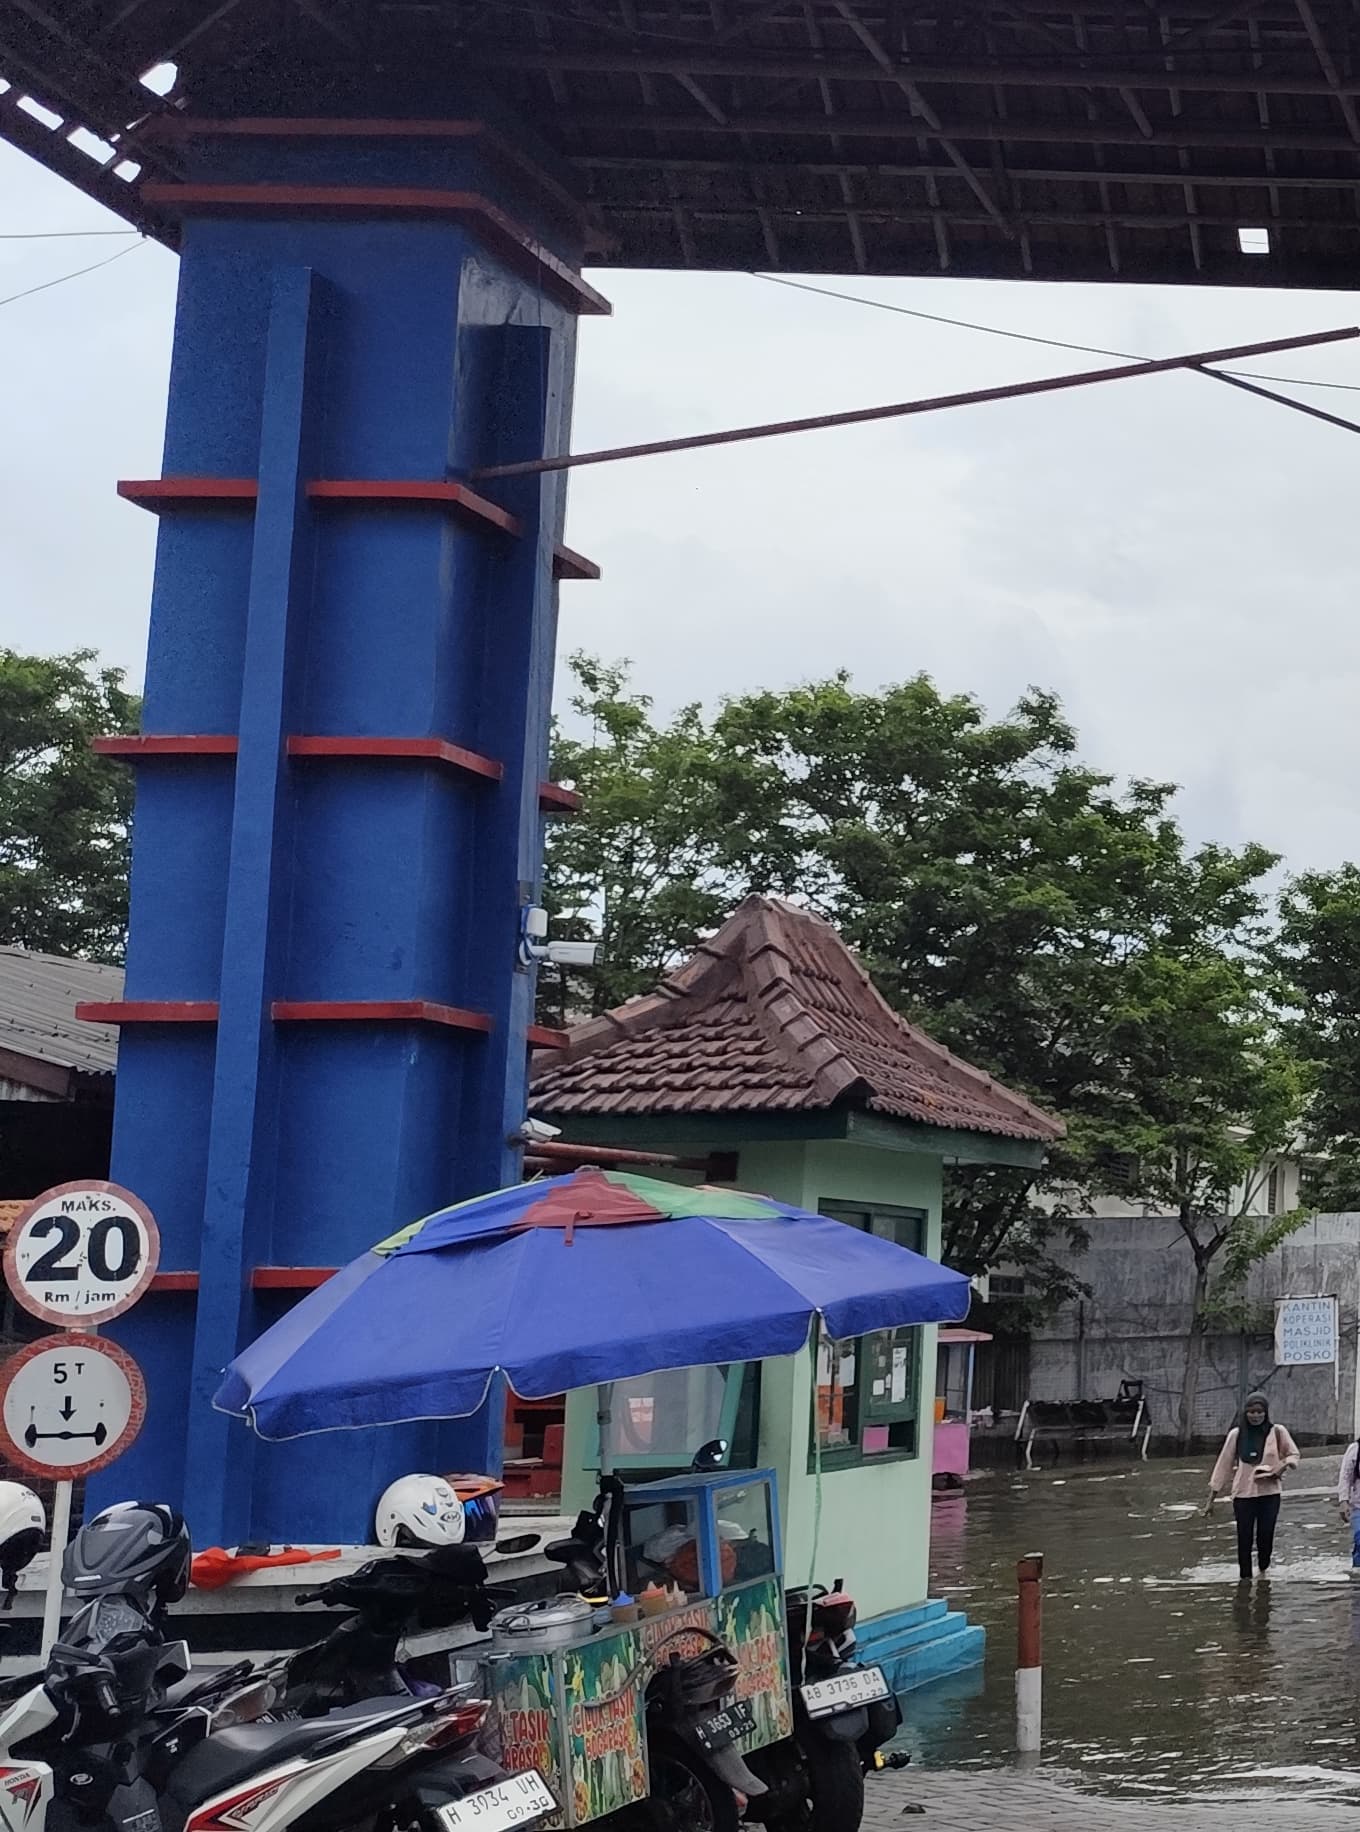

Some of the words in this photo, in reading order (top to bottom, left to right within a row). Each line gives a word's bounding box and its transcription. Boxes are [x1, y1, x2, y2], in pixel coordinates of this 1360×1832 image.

[25, 1215, 141, 1282] 20
[84, 1289, 116, 1305] jam
[1282, 1301, 1331, 1313] KANTIN
[1282, 1314, 1332, 1325] KOPERASI
[1283, 1325, 1332, 1337] MASJID
[1283, 1350, 1332, 1361] POSKO
[53, 1362, 68, 1384] 5
[806, 1685, 822, 1701] AB
[695, 1726, 706, 1740] H
[446, 1806, 462, 1825] H
